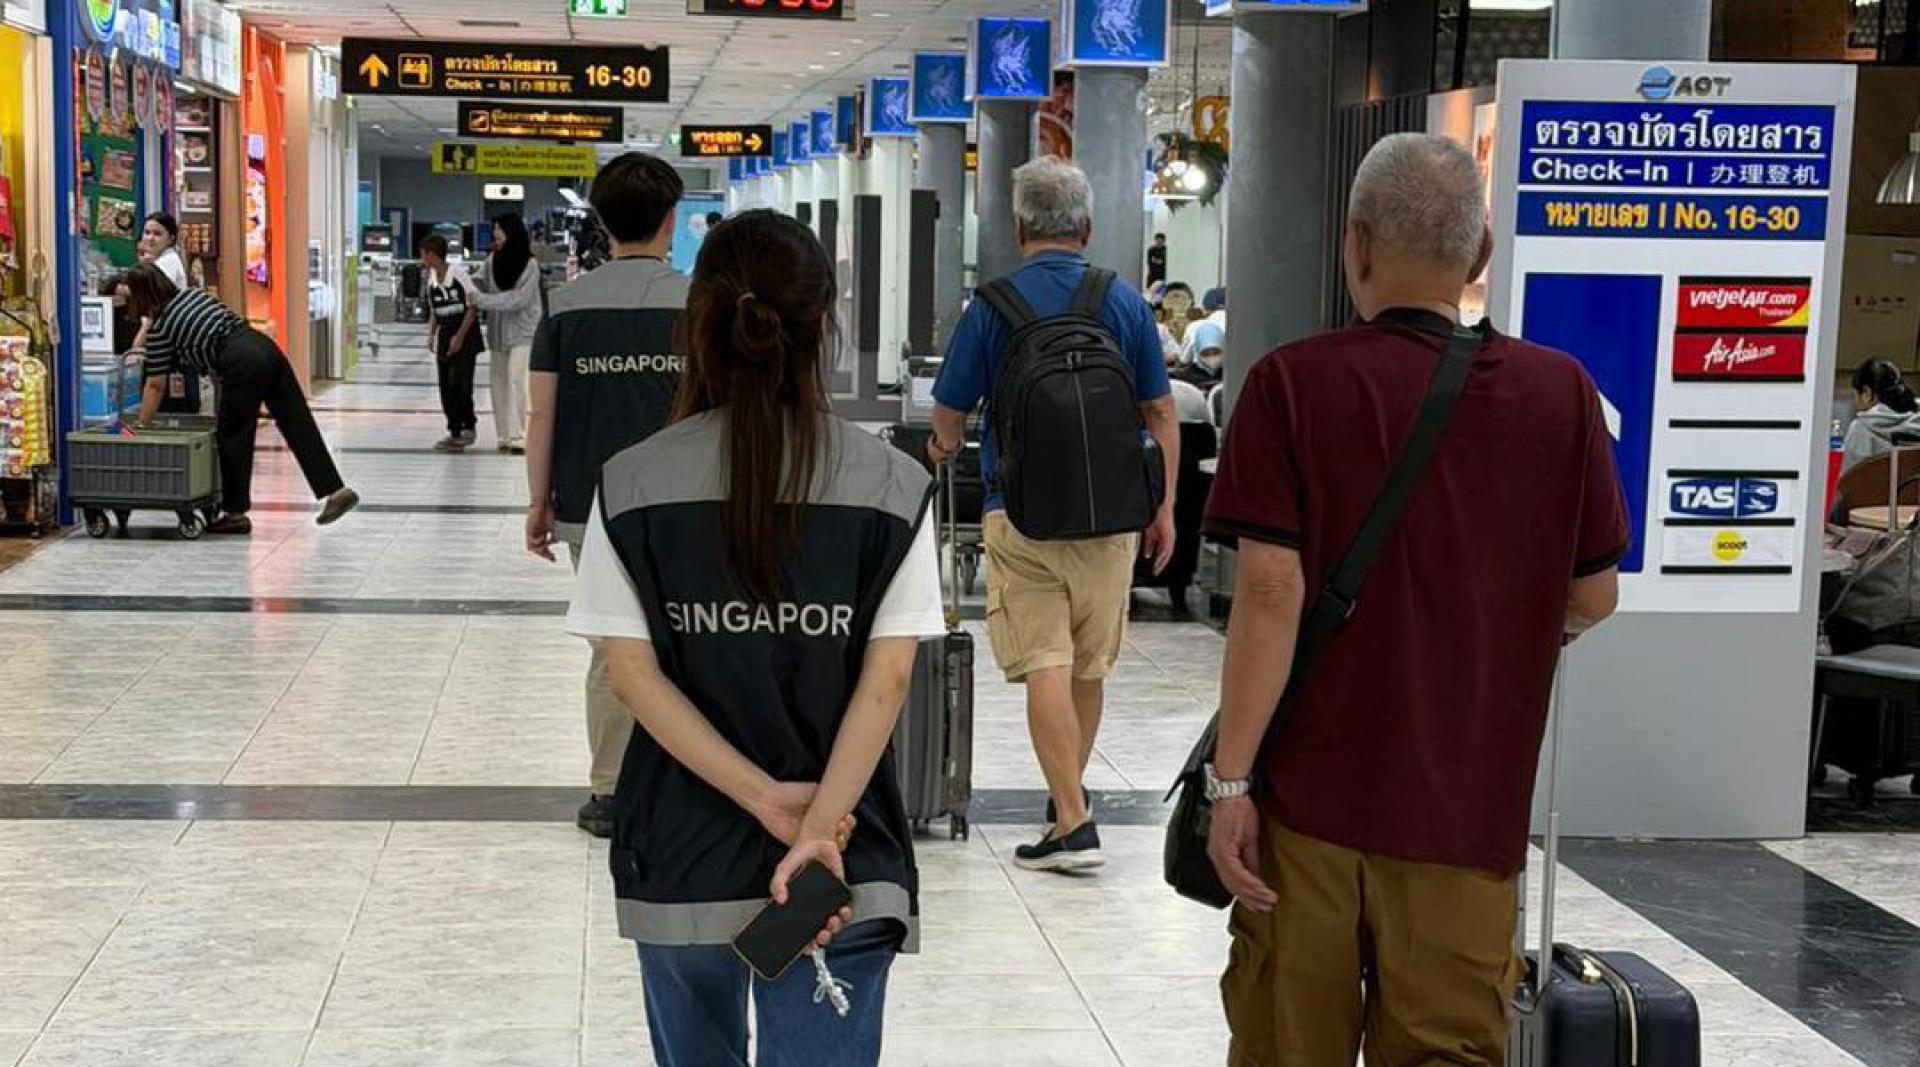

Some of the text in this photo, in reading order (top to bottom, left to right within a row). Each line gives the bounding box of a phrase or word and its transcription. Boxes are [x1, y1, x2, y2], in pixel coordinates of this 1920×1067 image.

[584, 64, 652, 88] 16-30
[1674, 76, 1732, 96] AOT
[1536, 109, 1821, 150] ตรวจบัตรโดยสาร
[1531, 159, 1669, 182] Check-In
[1710, 164, 1820, 186] 办理登机
[1545, 200, 1649, 229] หมายเลข
[1674, 203, 1718, 230] No.
[1725, 205, 1799, 231] 16-30
[1674, 485, 1735, 508] TAS
[664, 600, 854, 636] SINGAPOR
